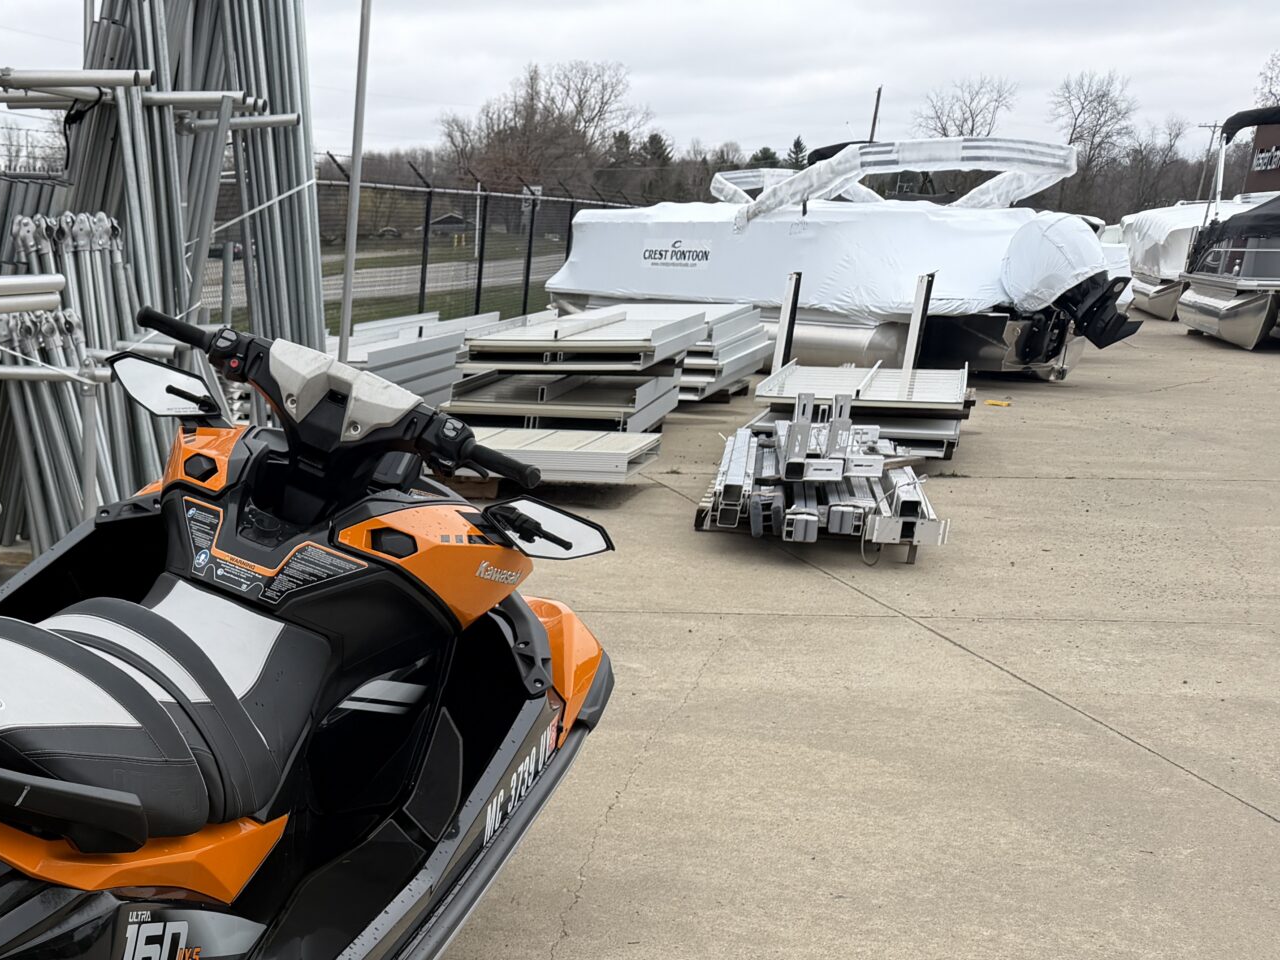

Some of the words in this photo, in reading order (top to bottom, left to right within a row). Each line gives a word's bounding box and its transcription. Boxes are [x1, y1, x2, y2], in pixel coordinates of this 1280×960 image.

[643, 249, 669, 260] CREST
[670, 249, 710, 261] PONTOON
[229, 555, 256, 571] WARNING
[483, 788, 504, 846] MC
[507, 747, 536, 813] 3739
[128, 911, 151, 922] ULTRA
